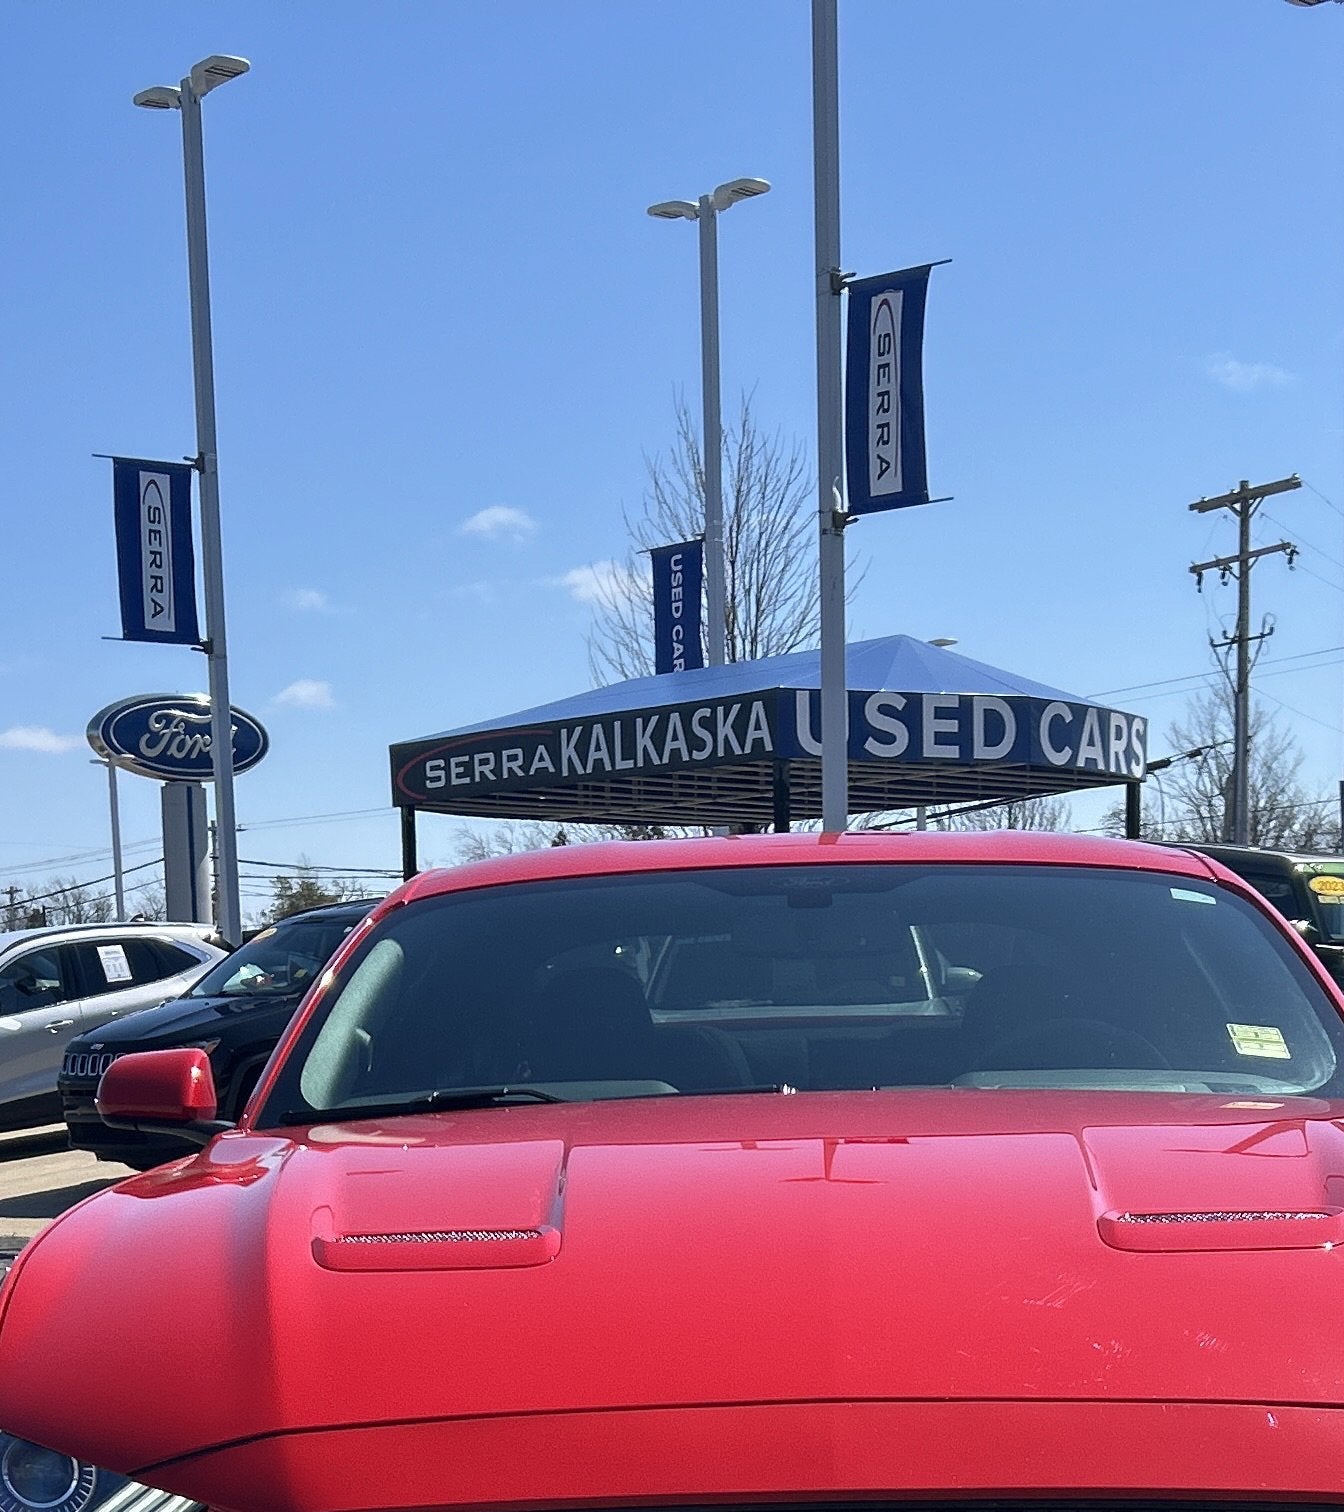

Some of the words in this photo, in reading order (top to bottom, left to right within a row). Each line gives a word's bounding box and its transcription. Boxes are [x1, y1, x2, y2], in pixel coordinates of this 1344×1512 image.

[876, 332, 891, 481] SERRA
[146, 505, 165, 619] SERRA
[670, 553, 683, 619] USED
[672, 624, 685, 673] CAR
[139, 709, 238, 759] For
[425, 744, 556, 789] SERRA
[560, 701, 774, 777] KALKASKA
[1040, 701, 1146, 778] CARS
